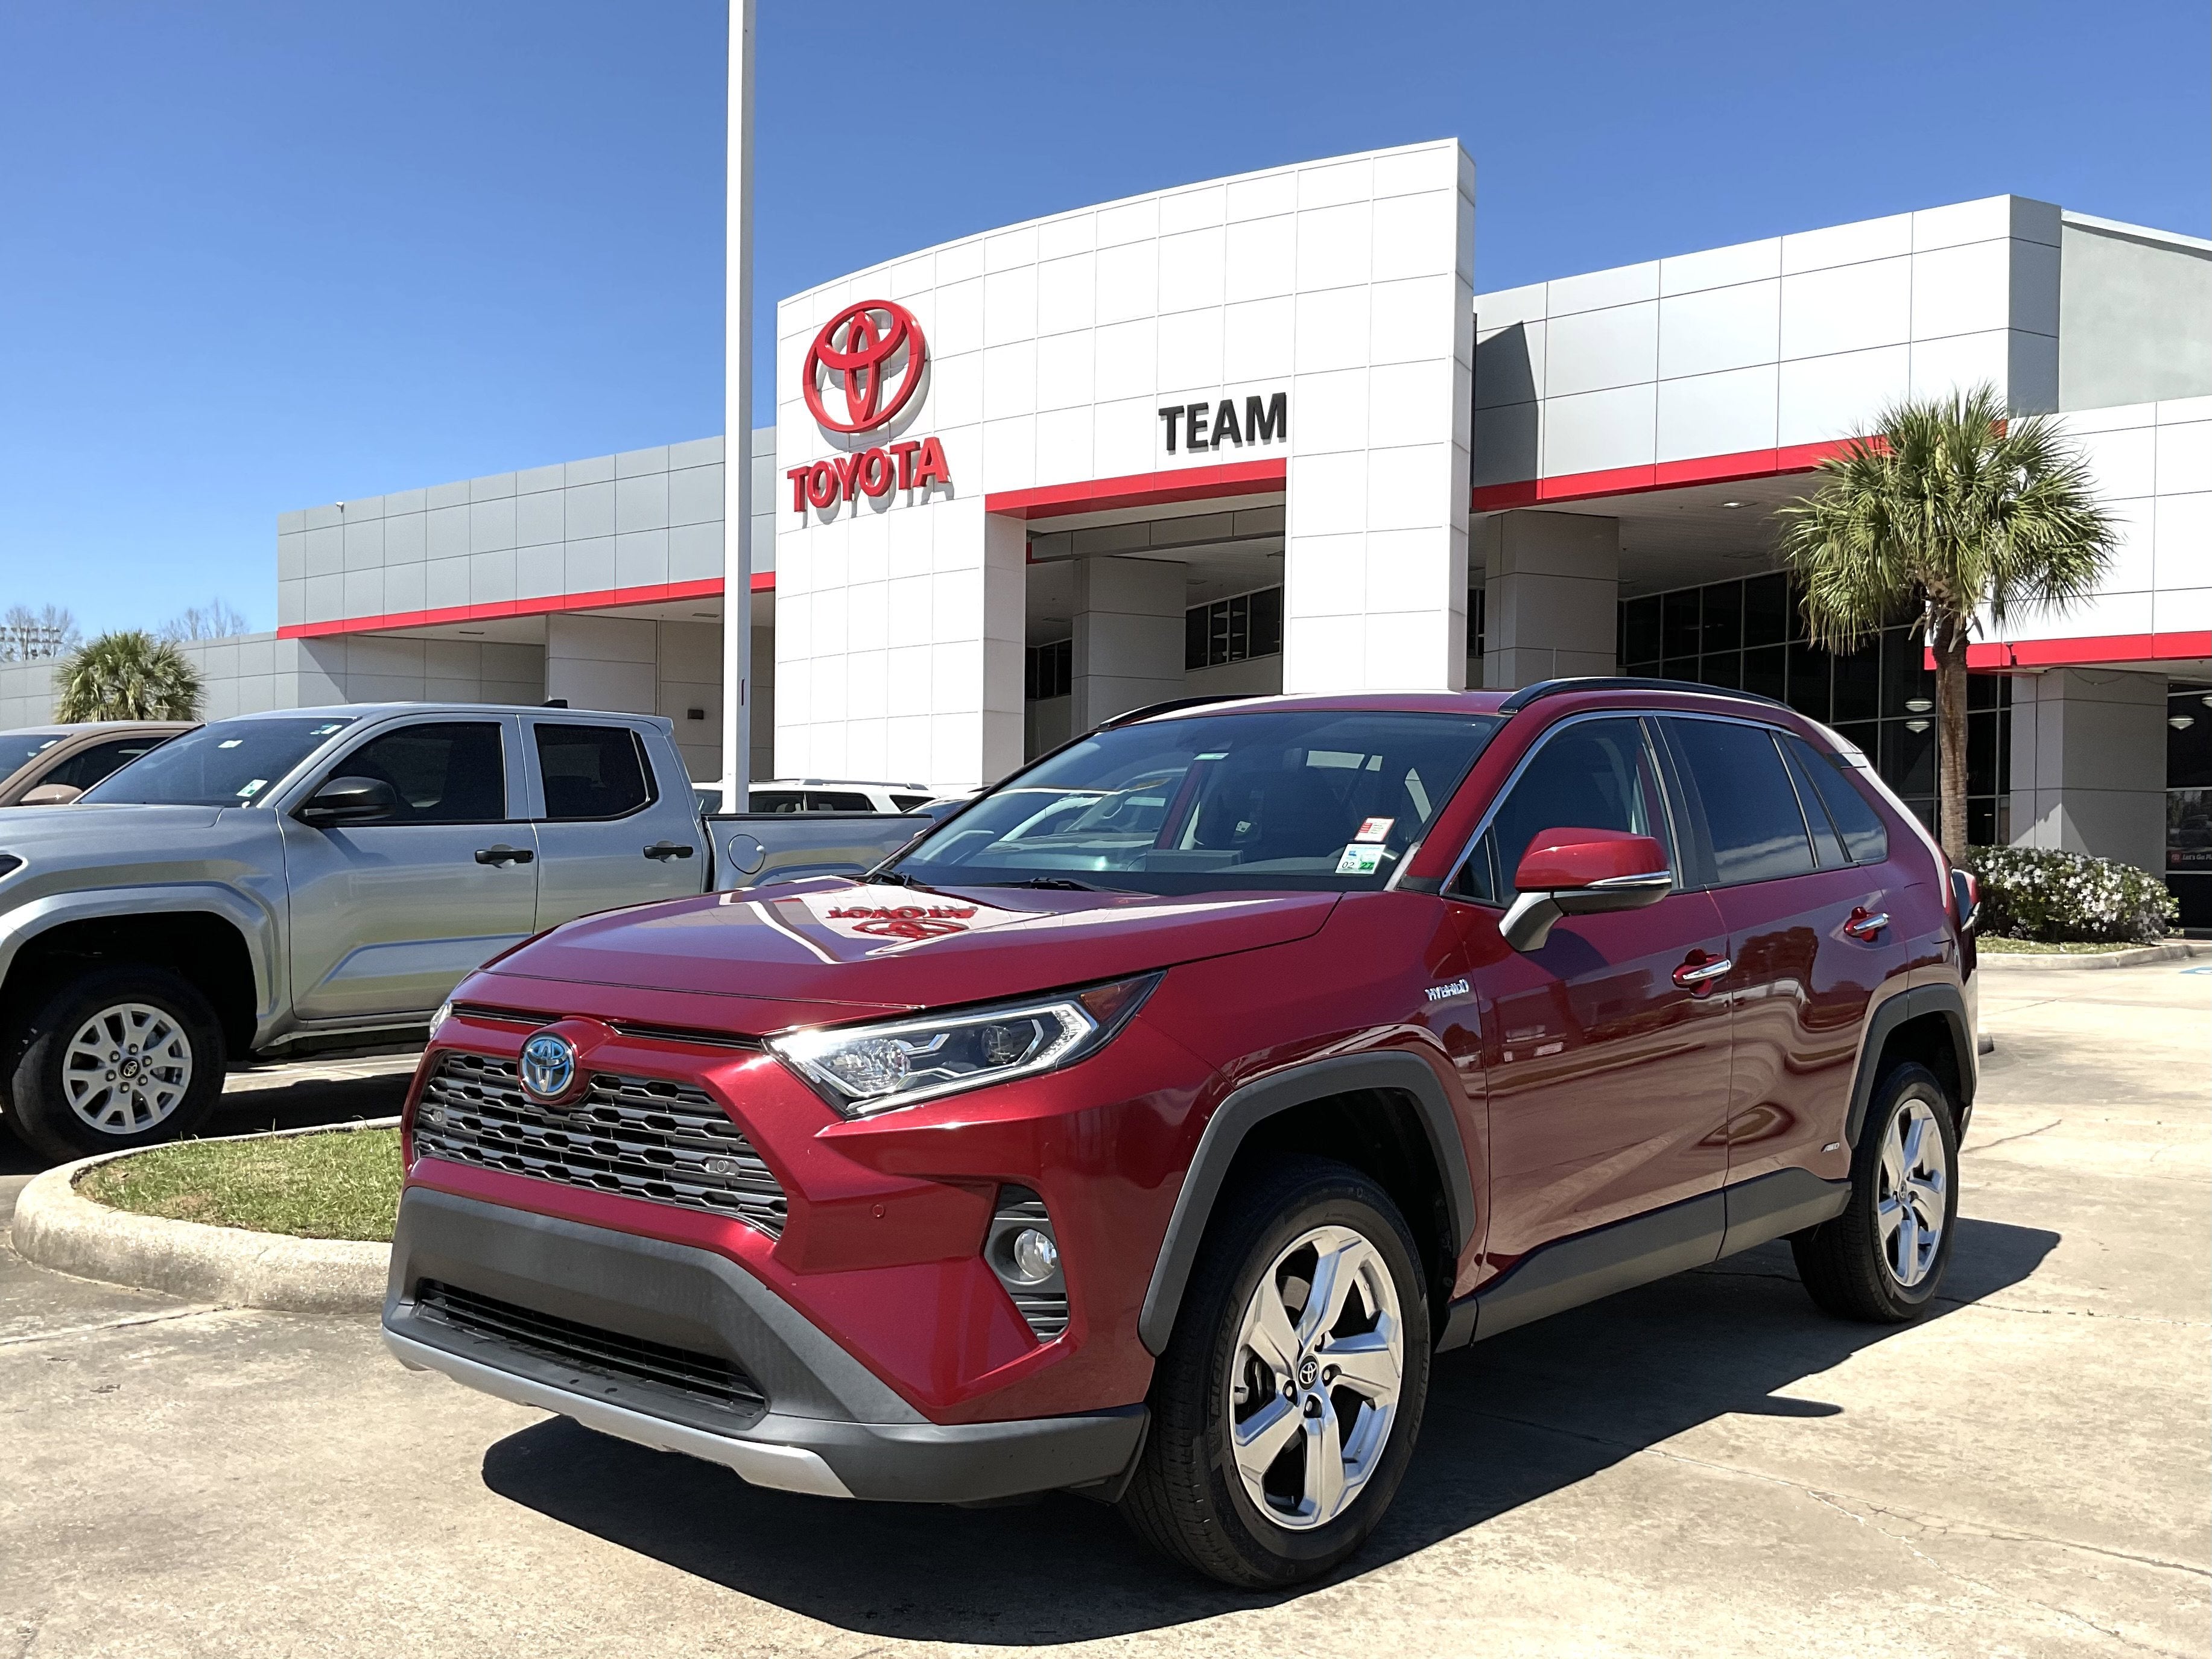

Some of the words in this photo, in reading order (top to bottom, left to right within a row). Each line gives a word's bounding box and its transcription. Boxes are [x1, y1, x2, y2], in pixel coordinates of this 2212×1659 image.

[1159, 392, 1286, 451] TEAM
[787, 437, 951, 512] TOYOTA
[1425, 979, 1469, 1001] HYBRID
